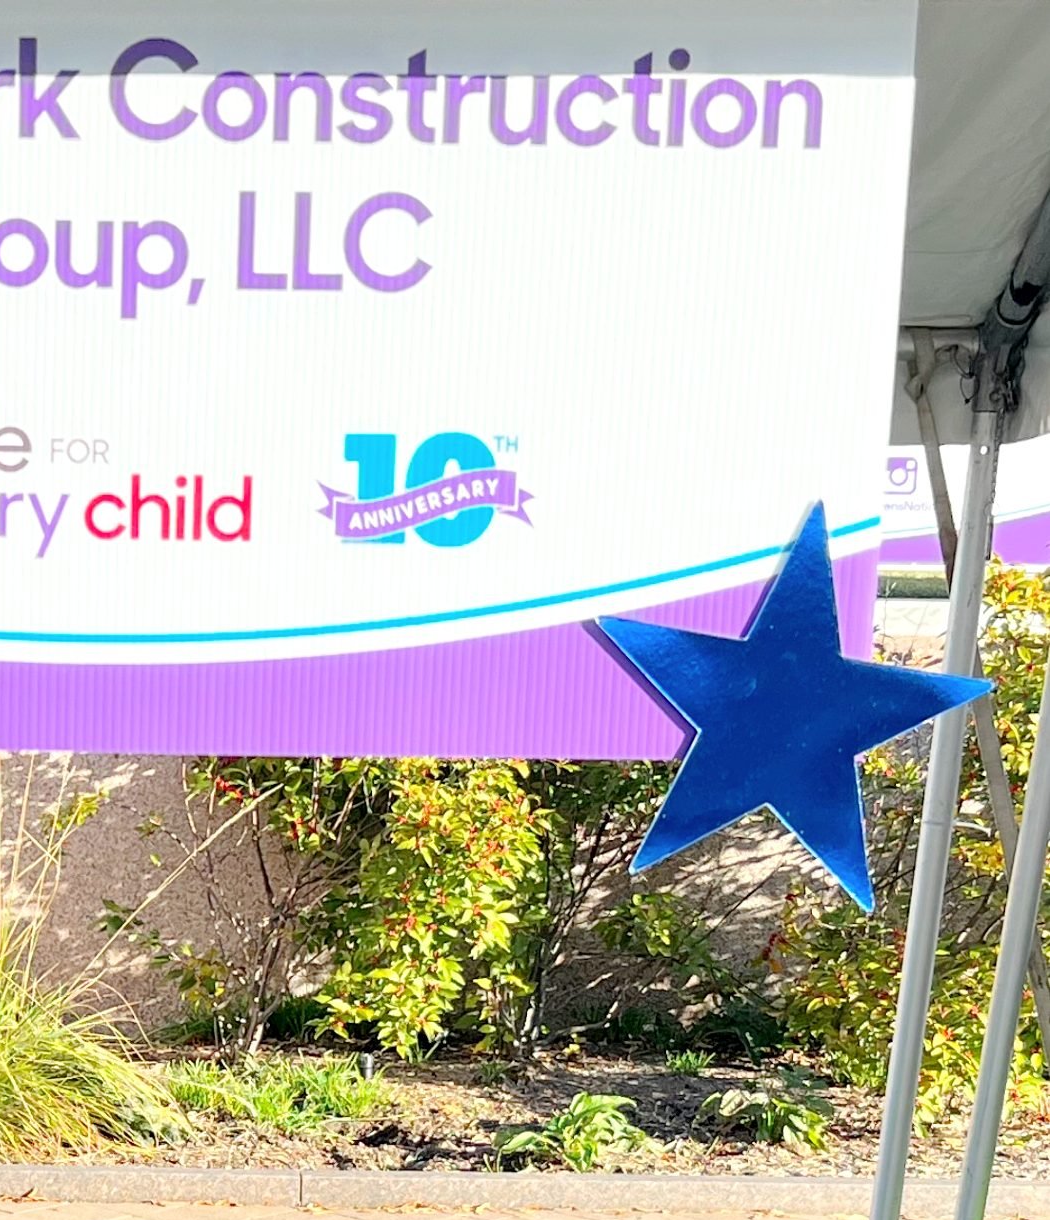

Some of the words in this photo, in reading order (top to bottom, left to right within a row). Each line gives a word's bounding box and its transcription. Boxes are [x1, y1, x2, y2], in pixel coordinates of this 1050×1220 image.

[109, 37, 824, 149] Construction
[237, 190, 434, 293] LLC
[50, 438, 110, 464] FOR
[341, 432, 496, 547] 10
[84, 473, 253, 542] child
[348, 477, 500, 530] ANNIVERSARY
